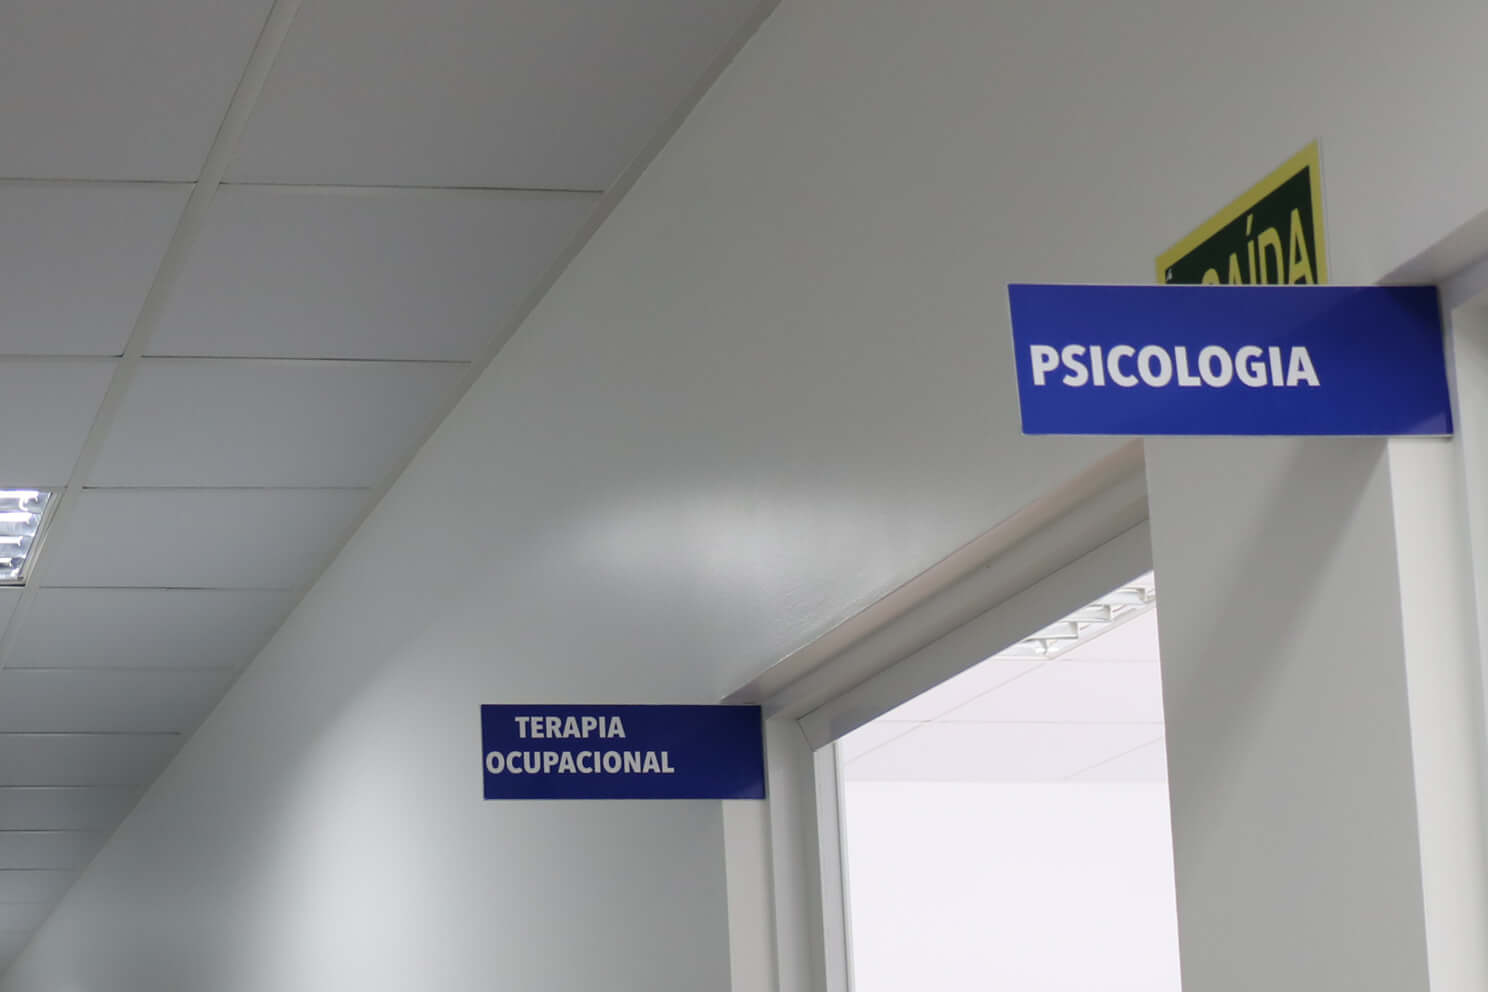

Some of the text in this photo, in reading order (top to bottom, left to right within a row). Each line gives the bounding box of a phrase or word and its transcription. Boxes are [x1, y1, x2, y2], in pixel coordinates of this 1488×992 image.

[1029, 344, 1321, 388] PSICOLOGIA
[514, 716, 626, 739] TERAPIA
[485, 750, 675, 774] OCUPACIONAL
